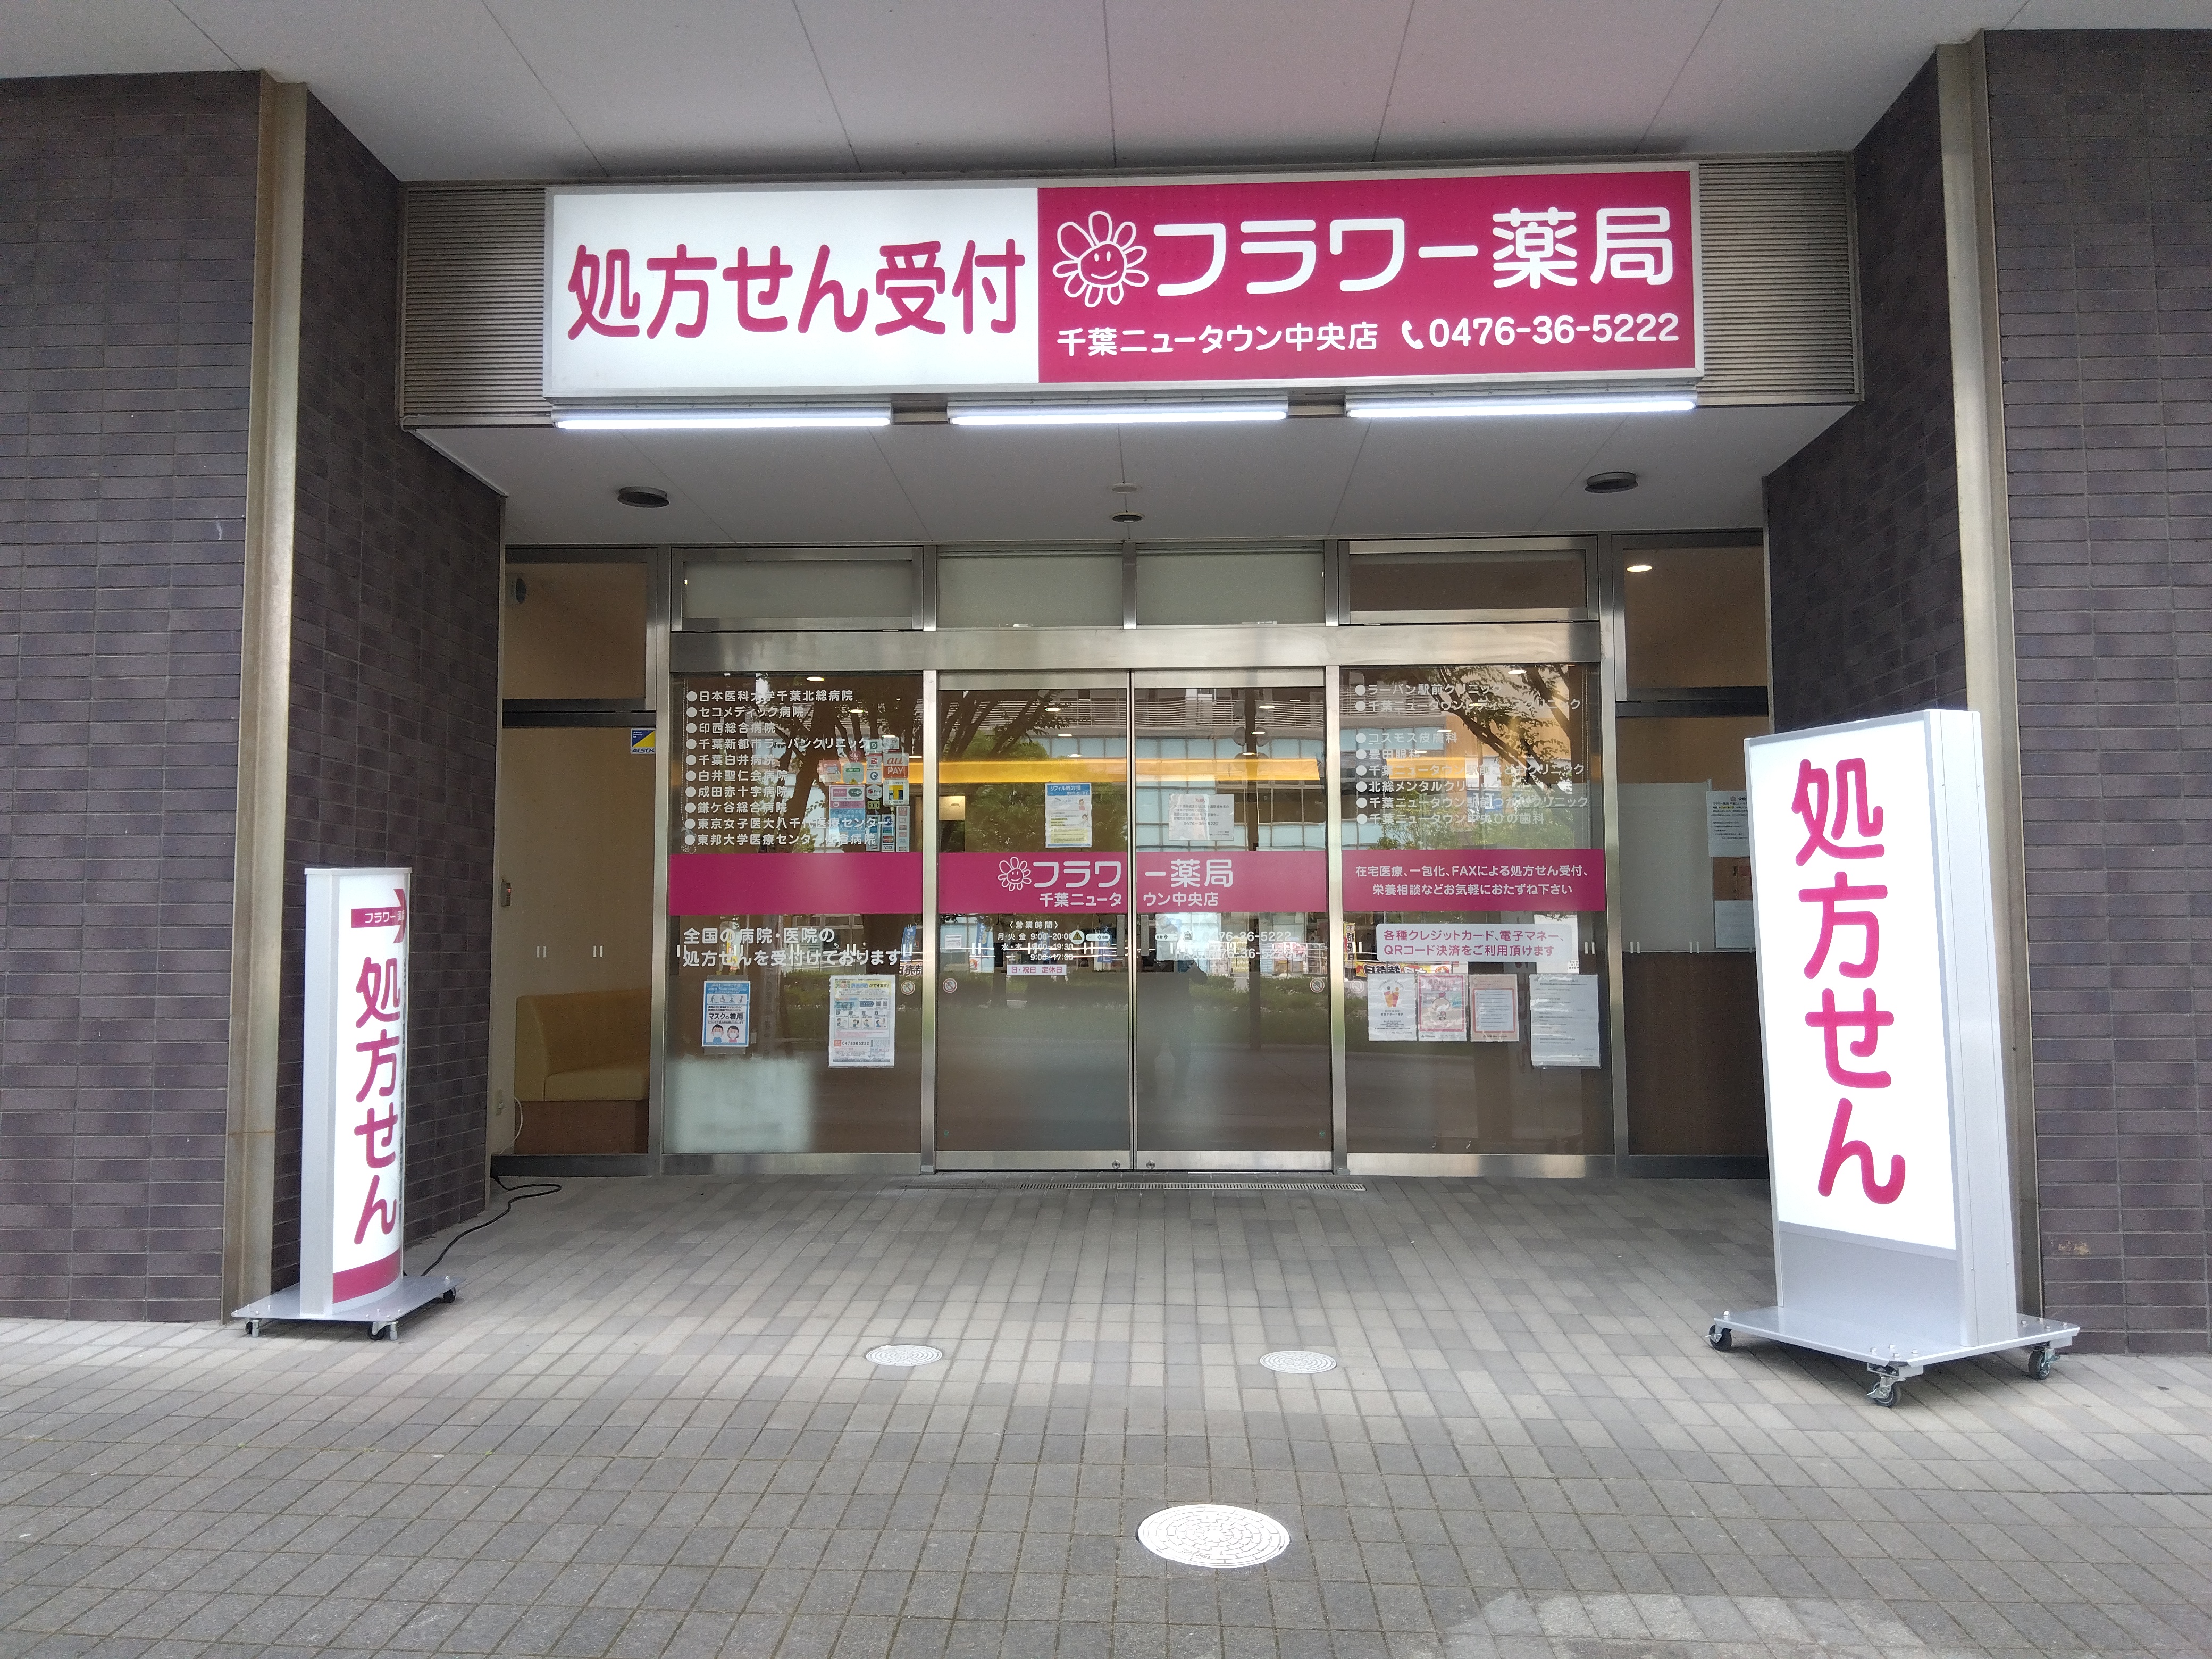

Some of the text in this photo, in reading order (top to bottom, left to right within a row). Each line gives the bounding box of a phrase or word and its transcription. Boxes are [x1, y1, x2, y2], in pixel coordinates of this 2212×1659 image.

[1153, 206, 1674, 297] フラワー薬局
[567, 238, 1026, 340] 処方せん受付
[1429, 313, 1680, 348] 0476-36-5222
[1057, 321, 1378, 357] 千葉ニュータウン中央店
[699, 690, 853, 702] 日本医科大学千葉北総病院
[699, 706, 804, 717] セコメディック病院
[699, 722, 776, 734] 印西総合病院
[1368, 732, 1457, 744] コスモス皮膚科
[698, 754, 775, 766] 千葉白井病院
[1369, 749, 1420, 760] 豊田眼科
[698, 769, 788, 782] 白井聖仁会病院
[887, 766, 904, 775] PAY
[698, 785, 788, 798] 成田赤十字病院
[1369, 780, 1501, 792] 北総メンタルクリック
[1369, 812, 1545, 824] 千葉ニュータウン中央ひの歯科
[1355, 865, 1589, 877] 在宅医療、一包化、FAXによる処方せん受付、
[1372, 884, 1573, 896] 栄養相談などお気軽におたずね下さい
[683, 927, 835, 944] 全国の病院・医院の
[1384, 929, 1564, 942] 各種クレジットカード、電子マネー、
[1384, 945, 1555, 957] QRコード決済をご利用頂けます
[683, 949, 902, 967] 処方せんを受付けております
[1791, 758, 1906, 1205] 処方せん
[354, 956, 401, 1245] 処方せん
